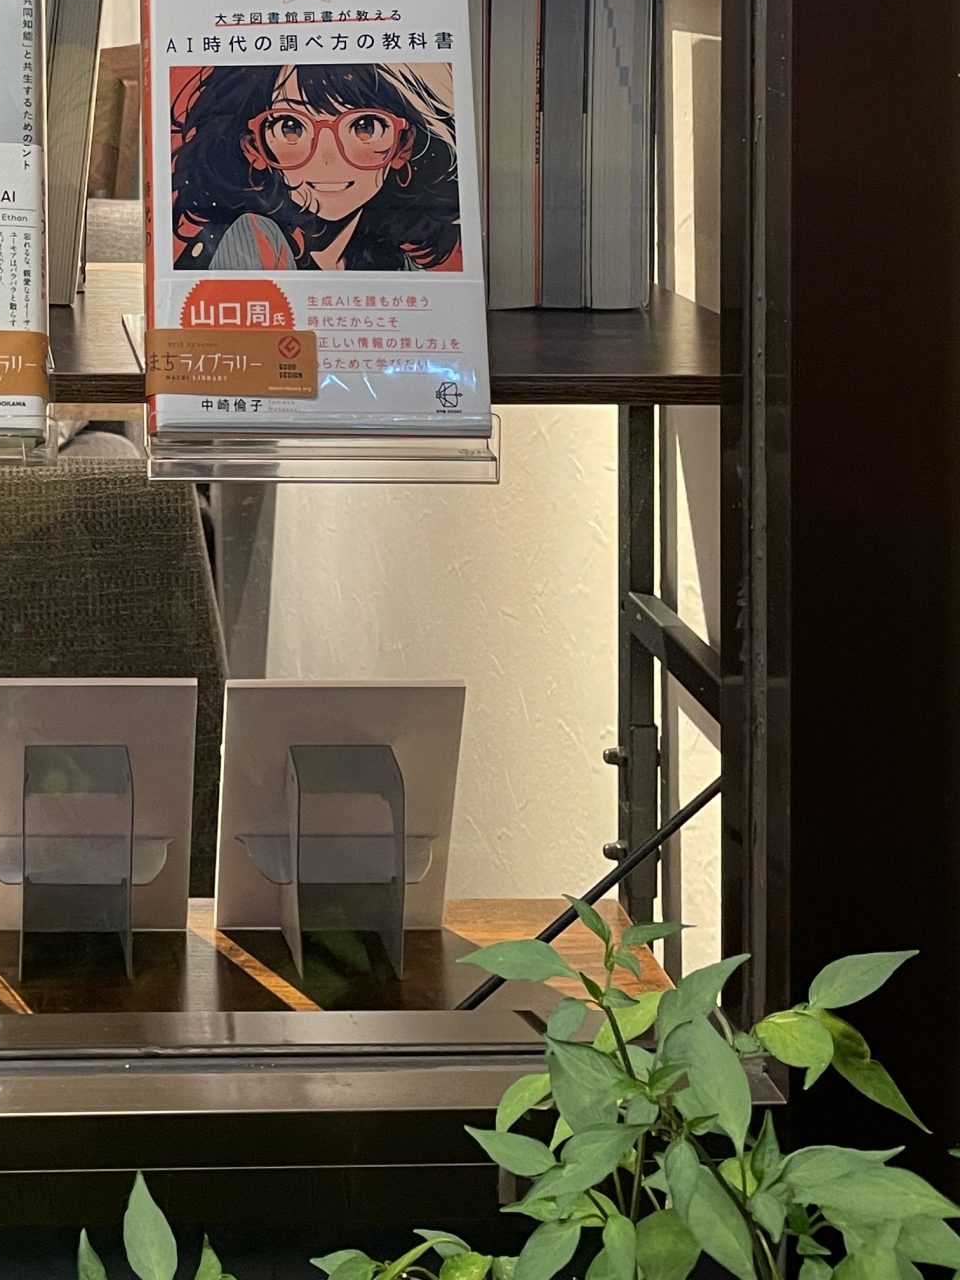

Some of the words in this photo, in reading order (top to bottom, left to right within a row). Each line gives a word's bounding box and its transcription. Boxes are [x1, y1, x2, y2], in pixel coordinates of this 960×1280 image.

[215, 10, 402, 25] 大学図書館司書が教える
[166, 31, 455, 53] AI時代の調べ方の教科書
[0, 191, 16, 203] AI
[2, 213, 28, 222] Ethan
[307, 295, 430, 307] 生成AIを誰もが使う
[190, 300, 286, 327] 山口周氏
[307, 316, 399, 328] 時代だからこそ
[148, 352, 263, 373] まちライブラリー
[201, 398, 263, 412] 中崎倫子
